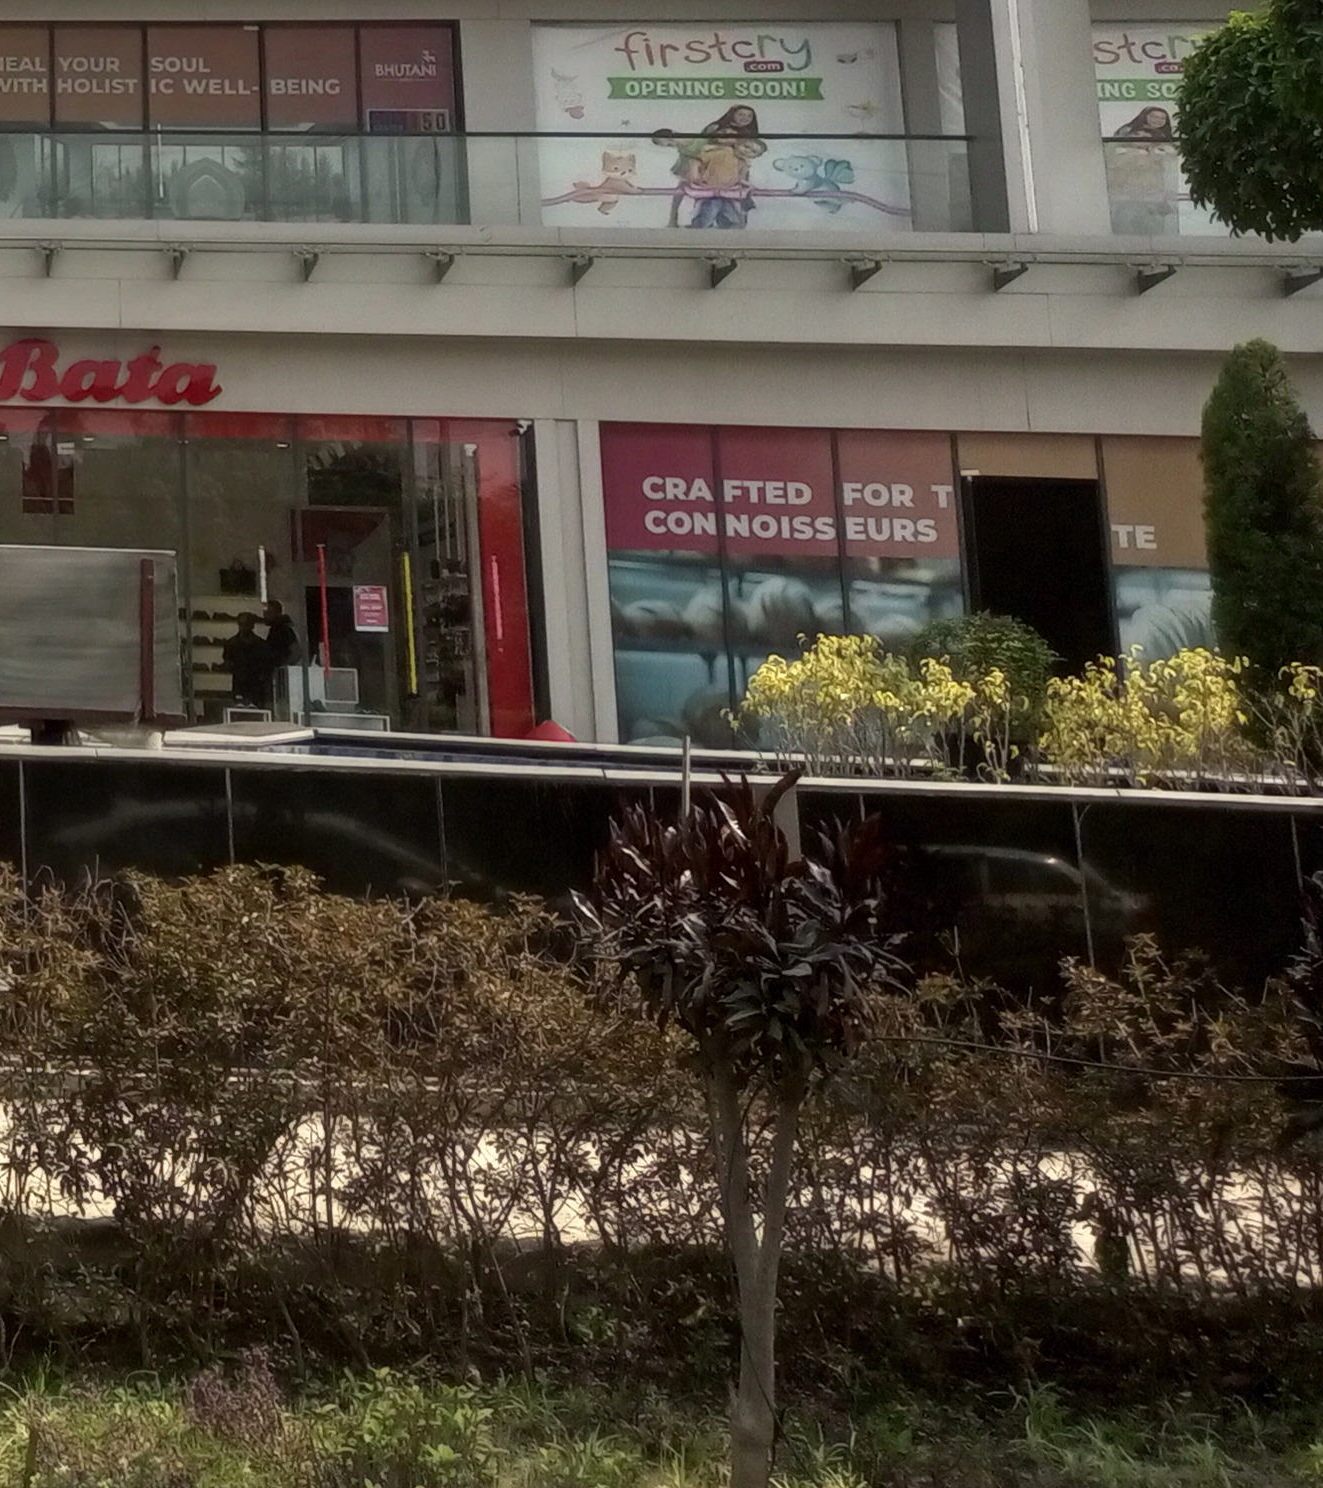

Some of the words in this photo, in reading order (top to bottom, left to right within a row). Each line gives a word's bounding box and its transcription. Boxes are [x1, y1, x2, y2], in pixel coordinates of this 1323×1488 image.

[614, 30, 812, 71] firstcry
[1093, 33, 1193, 65] stcr
[59, 56, 120, 72] YOUR
[150, 56, 211, 74] SOUL
[375, 64, 437, 77] BHUTANI
[625, 79, 725, 98] OPENING
[735, 80, 807, 97] SOON!
[843, 482, 914, 508] FOR
[1111, 524, 1157, 550] TE
